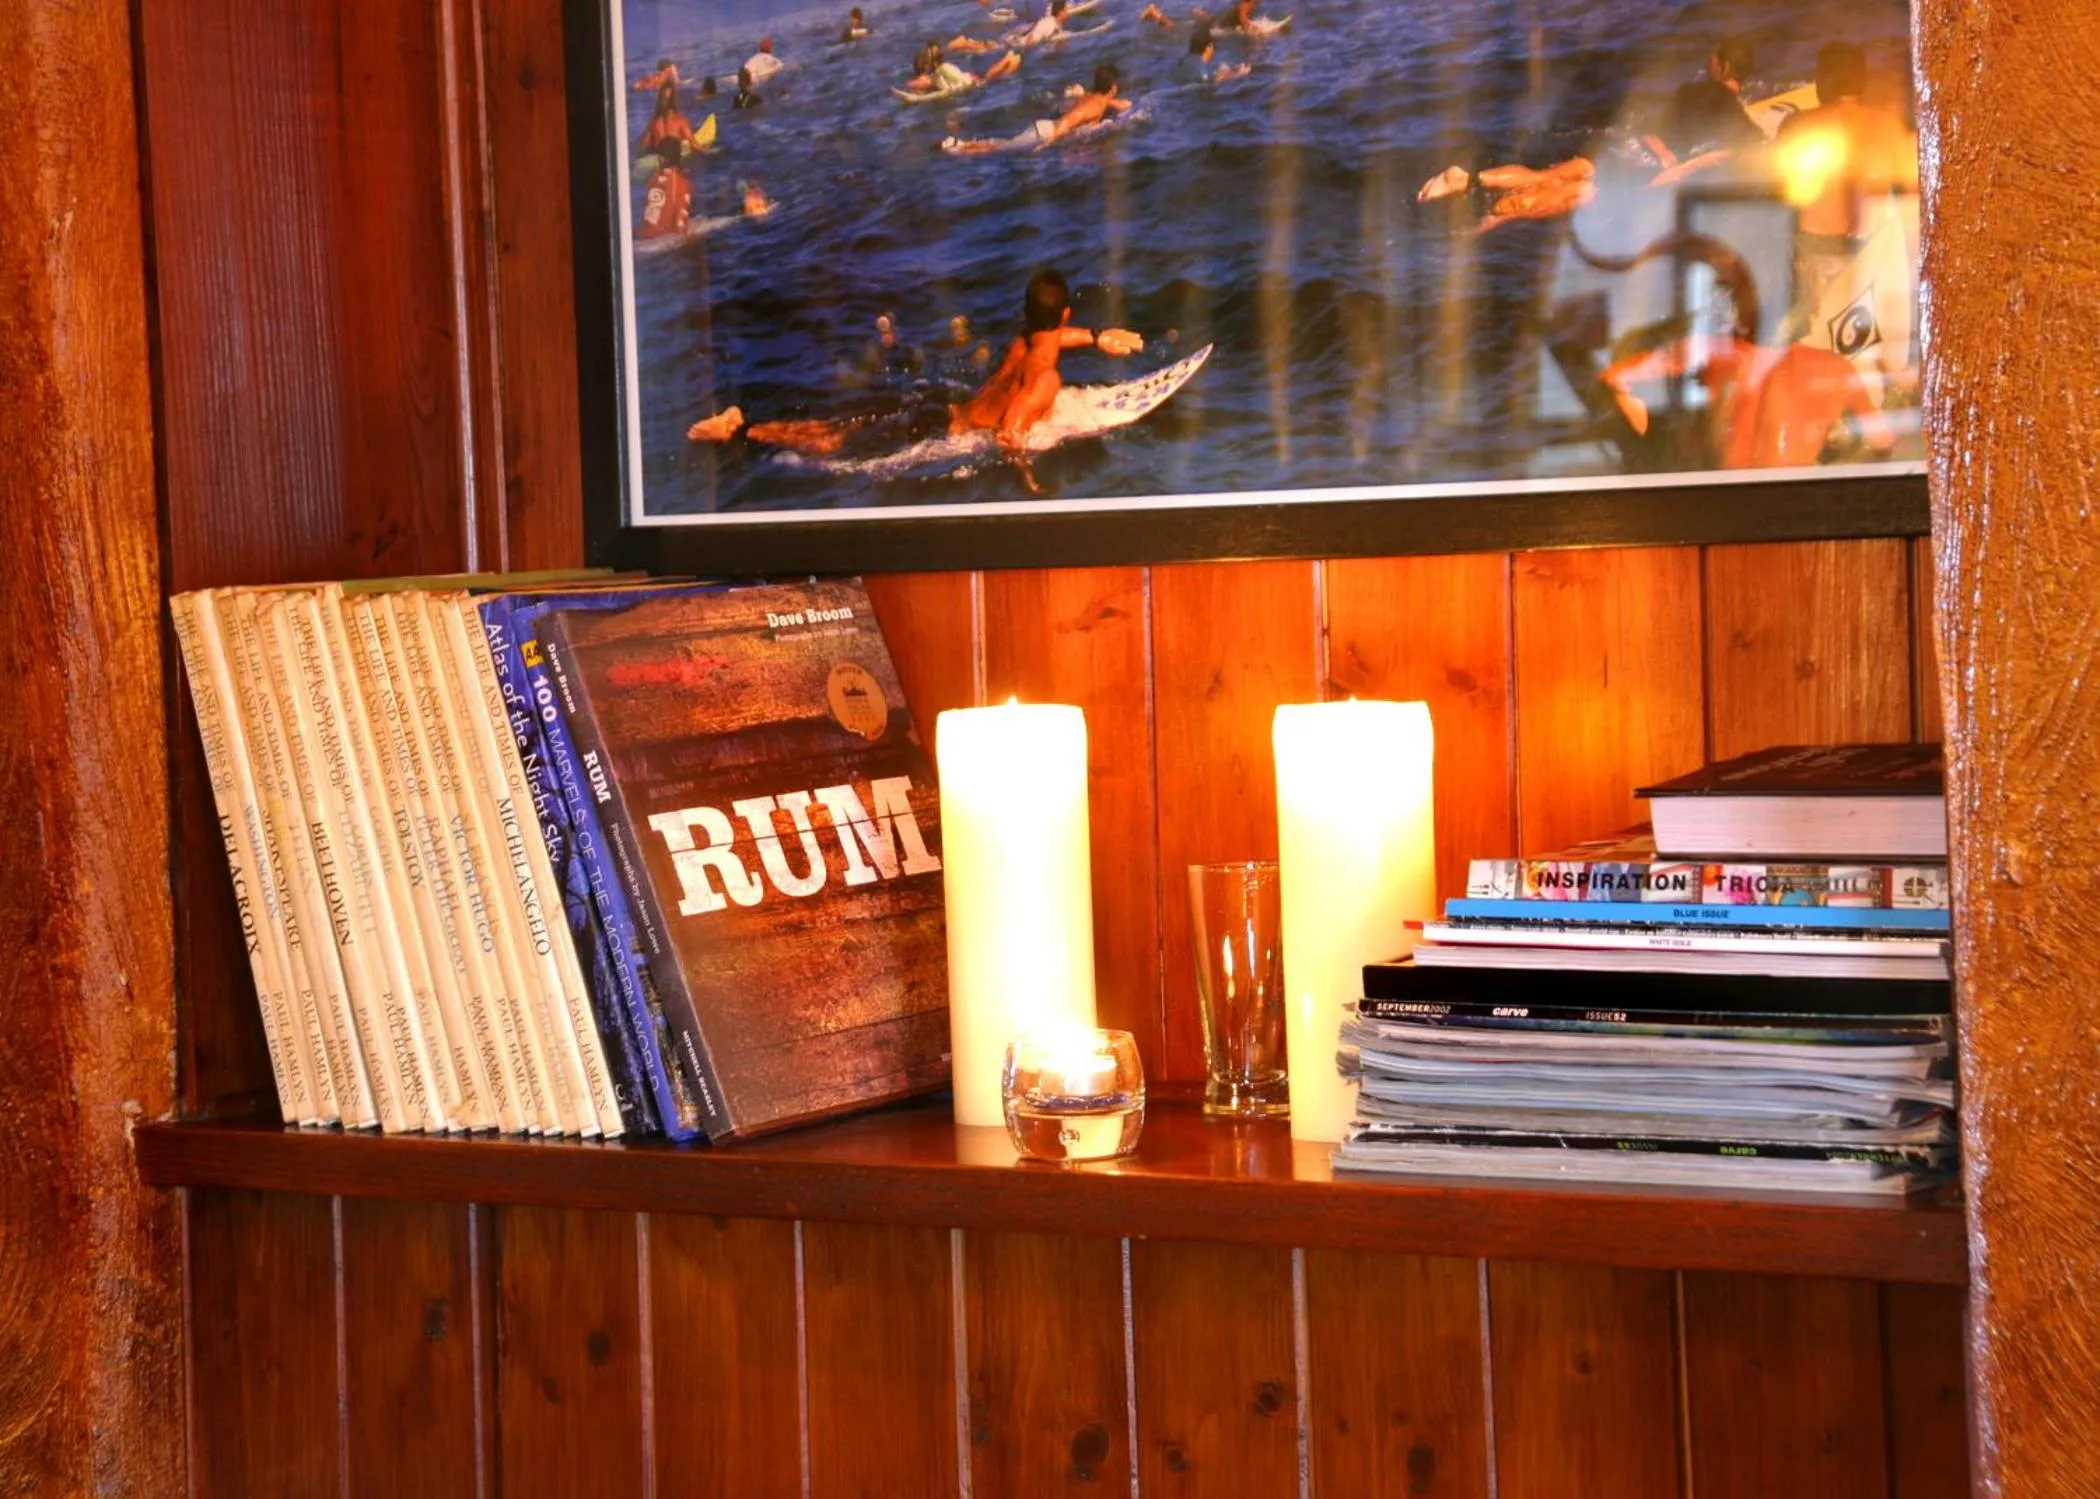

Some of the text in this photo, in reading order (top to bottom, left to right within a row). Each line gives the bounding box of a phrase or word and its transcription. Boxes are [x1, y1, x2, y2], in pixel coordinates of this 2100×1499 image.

[766, 606, 854, 628] Dave Broom
[184, 610, 234, 792] THE LIFE AND TIMES OF
[224, 610, 239, 642] THE
[232, 646, 248, 676] LIFE
[242, 686, 257, 718] AND
[251, 725, 270, 770] TIMES
[263, 774, 275, 794] OF
[240, 614, 256, 647] THE
[250, 655, 264, 684] LIFE
[258, 691, 273, 723] AND
[267, 729, 285, 776] TIMES
[279, 780, 291, 800] OF
[263, 618, 316, 803] THE LIFE AND TIMES OF
[301, 619, 352, 805] THE LIFE AND TIMES OF
[346, 615, 400, 800] THE LIFE AND TIMES OF
[360, 614, 417, 797] THE LIFE AND TIMES OF
[375, 614, 428, 797] THE LIFE AND TIMES OF
[398, 610, 451, 794] THE LIFE AND TIMES OF
[463, 608, 521, 794] THE LIFE AND TIMES OF
[547, 642, 576, 713] Dave Broom
[484, 620, 566, 863] Atlas of the Night Sky
[582, 749, 611, 803] RUM
[220, 814, 259, 955] DELACROIX
[243, 804, 278, 920] WASHINGTON
[312, 822, 351, 945] BEETHOVEN
[393, 806, 422, 889] TOLSTOY
[427, 817, 459, 911] RAPHAEL
[449, 814, 494, 952] VICTOR HUGO
[497, 797, 550, 955] MICHELANGELO
[532, 674, 662, 1090] 100 MARVELS OF THE MODERN WORLD
[610, 823, 660, 954] Photographs by Jason Lowe
[648, 775, 942, 916] RUM
[1538, 871, 1687, 891] INSPIRATION
[1673, 908, 1730, 919] BLUE ISSUE
[260, 994, 289, 1104] PAUL HAMLYN
[273, 991, 305, 1102] PAUL HAMLYN
[301, 989, 332, 1100] PAUL HAMLYN
[329, 994, 360, 1106] PAUL HAMLYN
[359, 1007, 391, 1120] PAUL HAMLYN
[383, 993, 415, 1105] PAUL HAMLYN
[398, 1007, 429, 1119] PAUL HAMLYN
[497, 998, 531, 1110] PAUL HAMLYN
[509, 998, 544, 1111] PAUL HAMLYN
[570, 997, 607, 1110] PAUL HAMLYN
[1492, 1006, 1530, 1017] carve
[326, 1039, 348, 1106] HAMLYN
[454, 1046, 478, 1112] HAMLYN
[682, 1030, 715, 1116] MITCHELL BEAZLEY
[1719, 1145, 1757, 1156] carve
